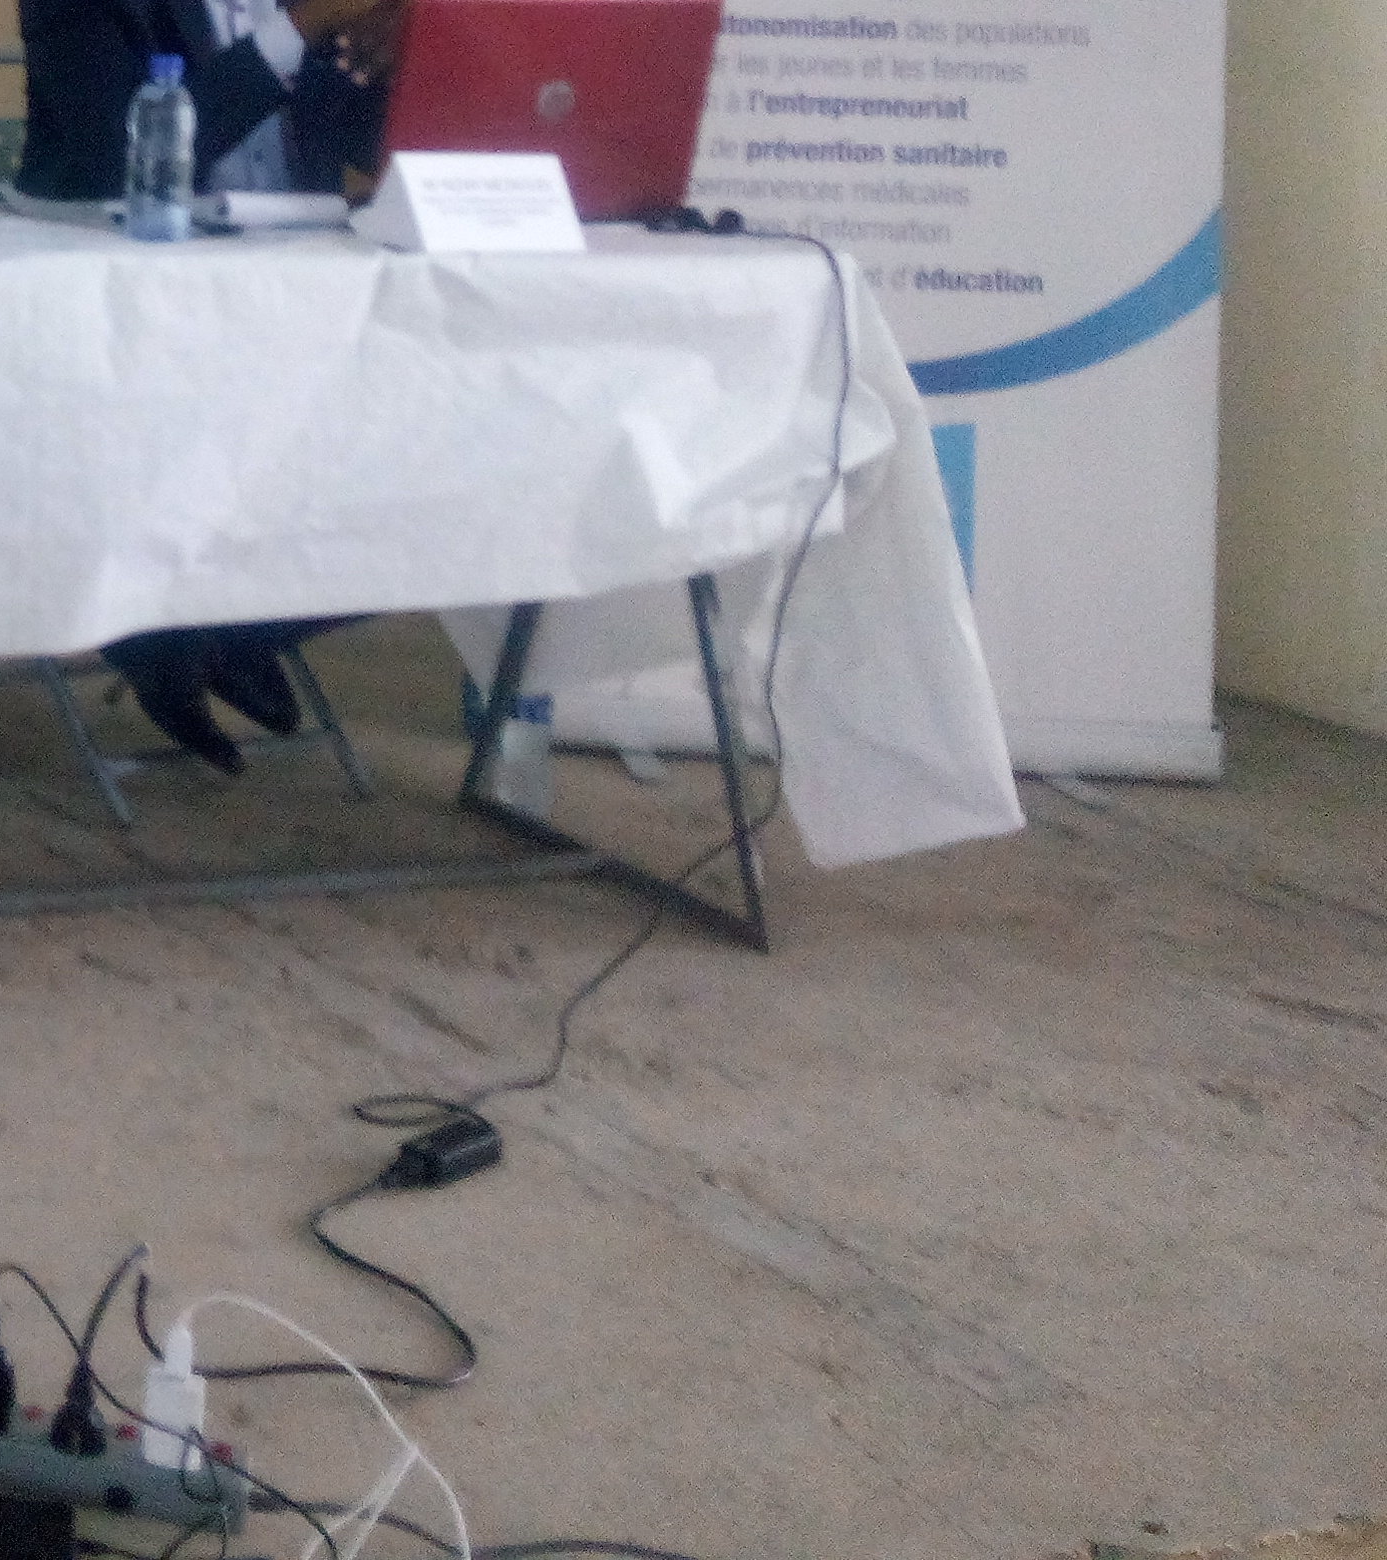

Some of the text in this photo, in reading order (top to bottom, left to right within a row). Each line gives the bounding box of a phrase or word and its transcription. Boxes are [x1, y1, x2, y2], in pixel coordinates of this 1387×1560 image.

[721, 15, 898, 40] tonomisation
[957, 21, 1091, 47] populations
[748, 90, 969, 121] l'entrepreneuriat
[747, 138, 885, 166] prévention
[892, 142, 1010, 170] sanitaire
